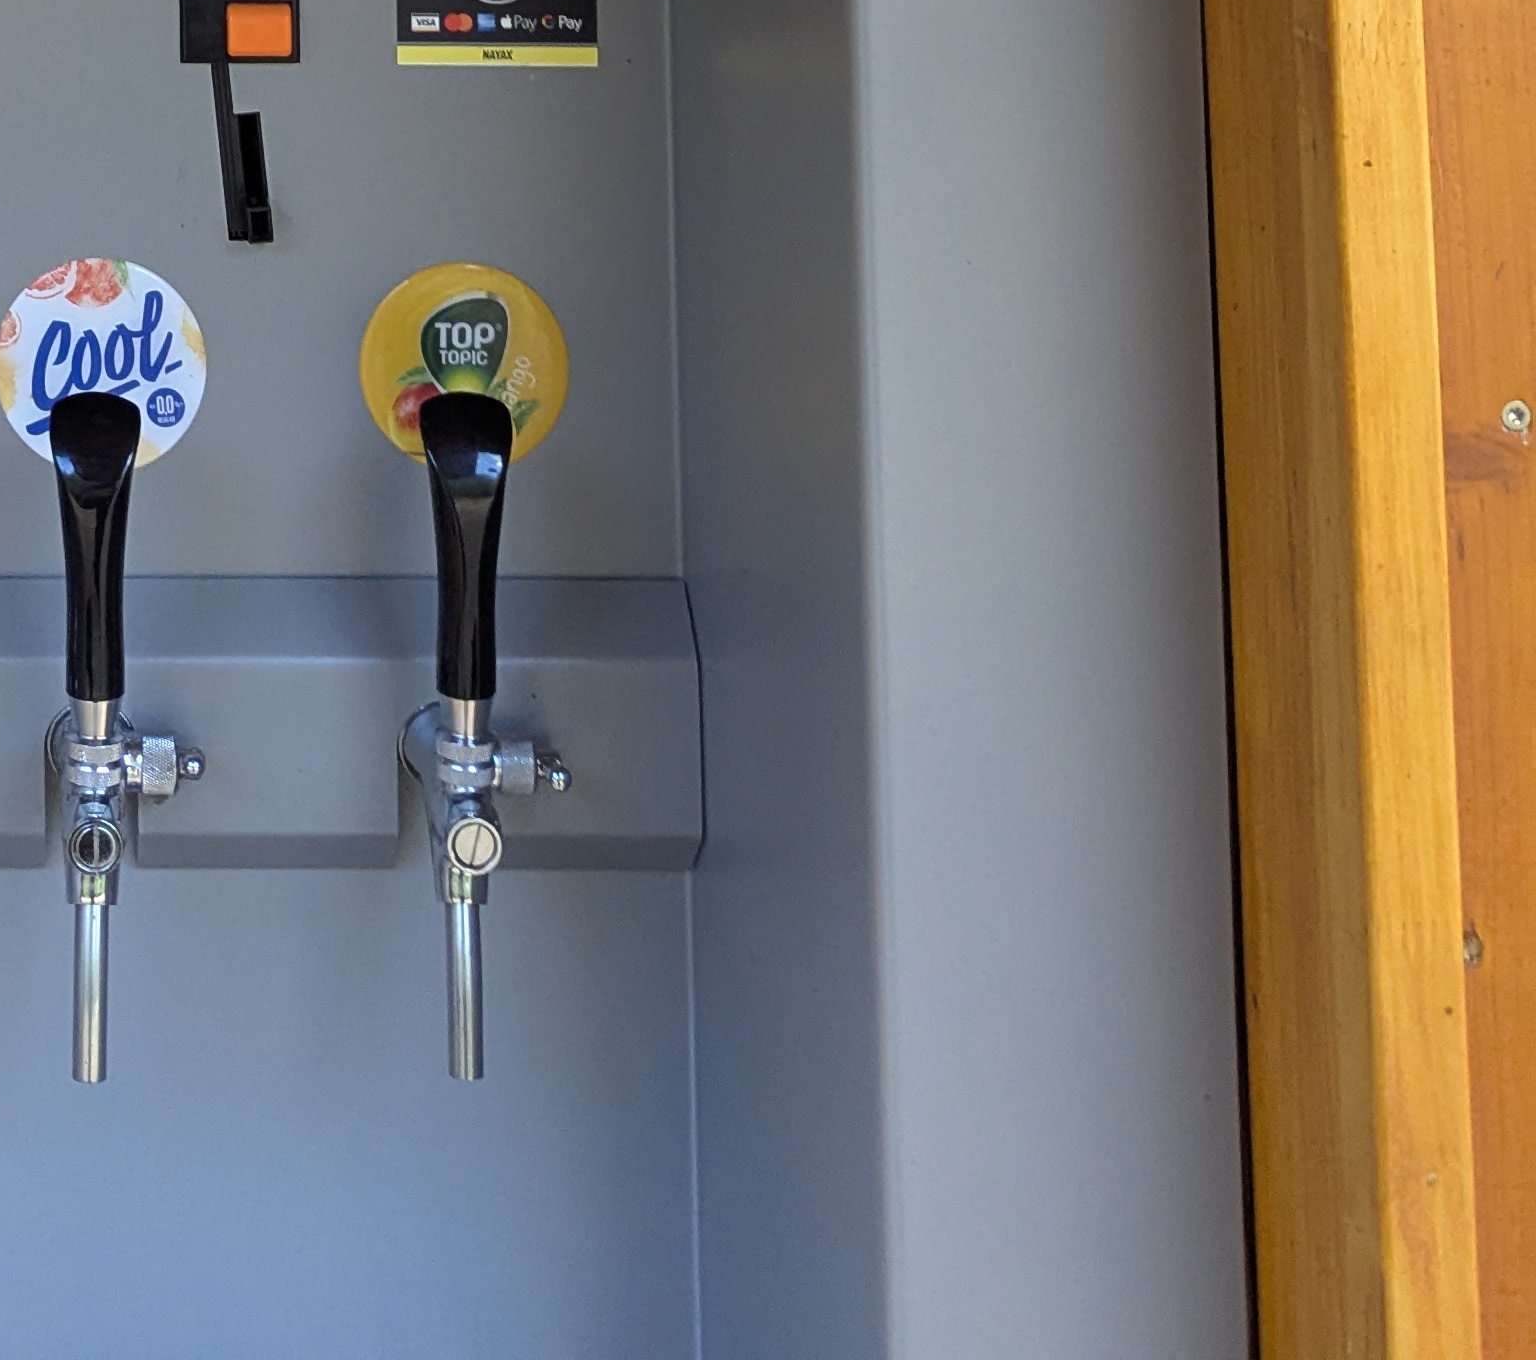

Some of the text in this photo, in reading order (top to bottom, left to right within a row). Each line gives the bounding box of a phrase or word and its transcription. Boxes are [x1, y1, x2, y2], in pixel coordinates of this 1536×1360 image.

[514, 14, 538, 32] Pay
[558, 14, 583, 33] Pay
[434, 321, 497, 350] TOP
[31, 290, 174, 412] Cool
[439, 349, 489, 366] TOPIC
[502, 356, 537, 406] ango
